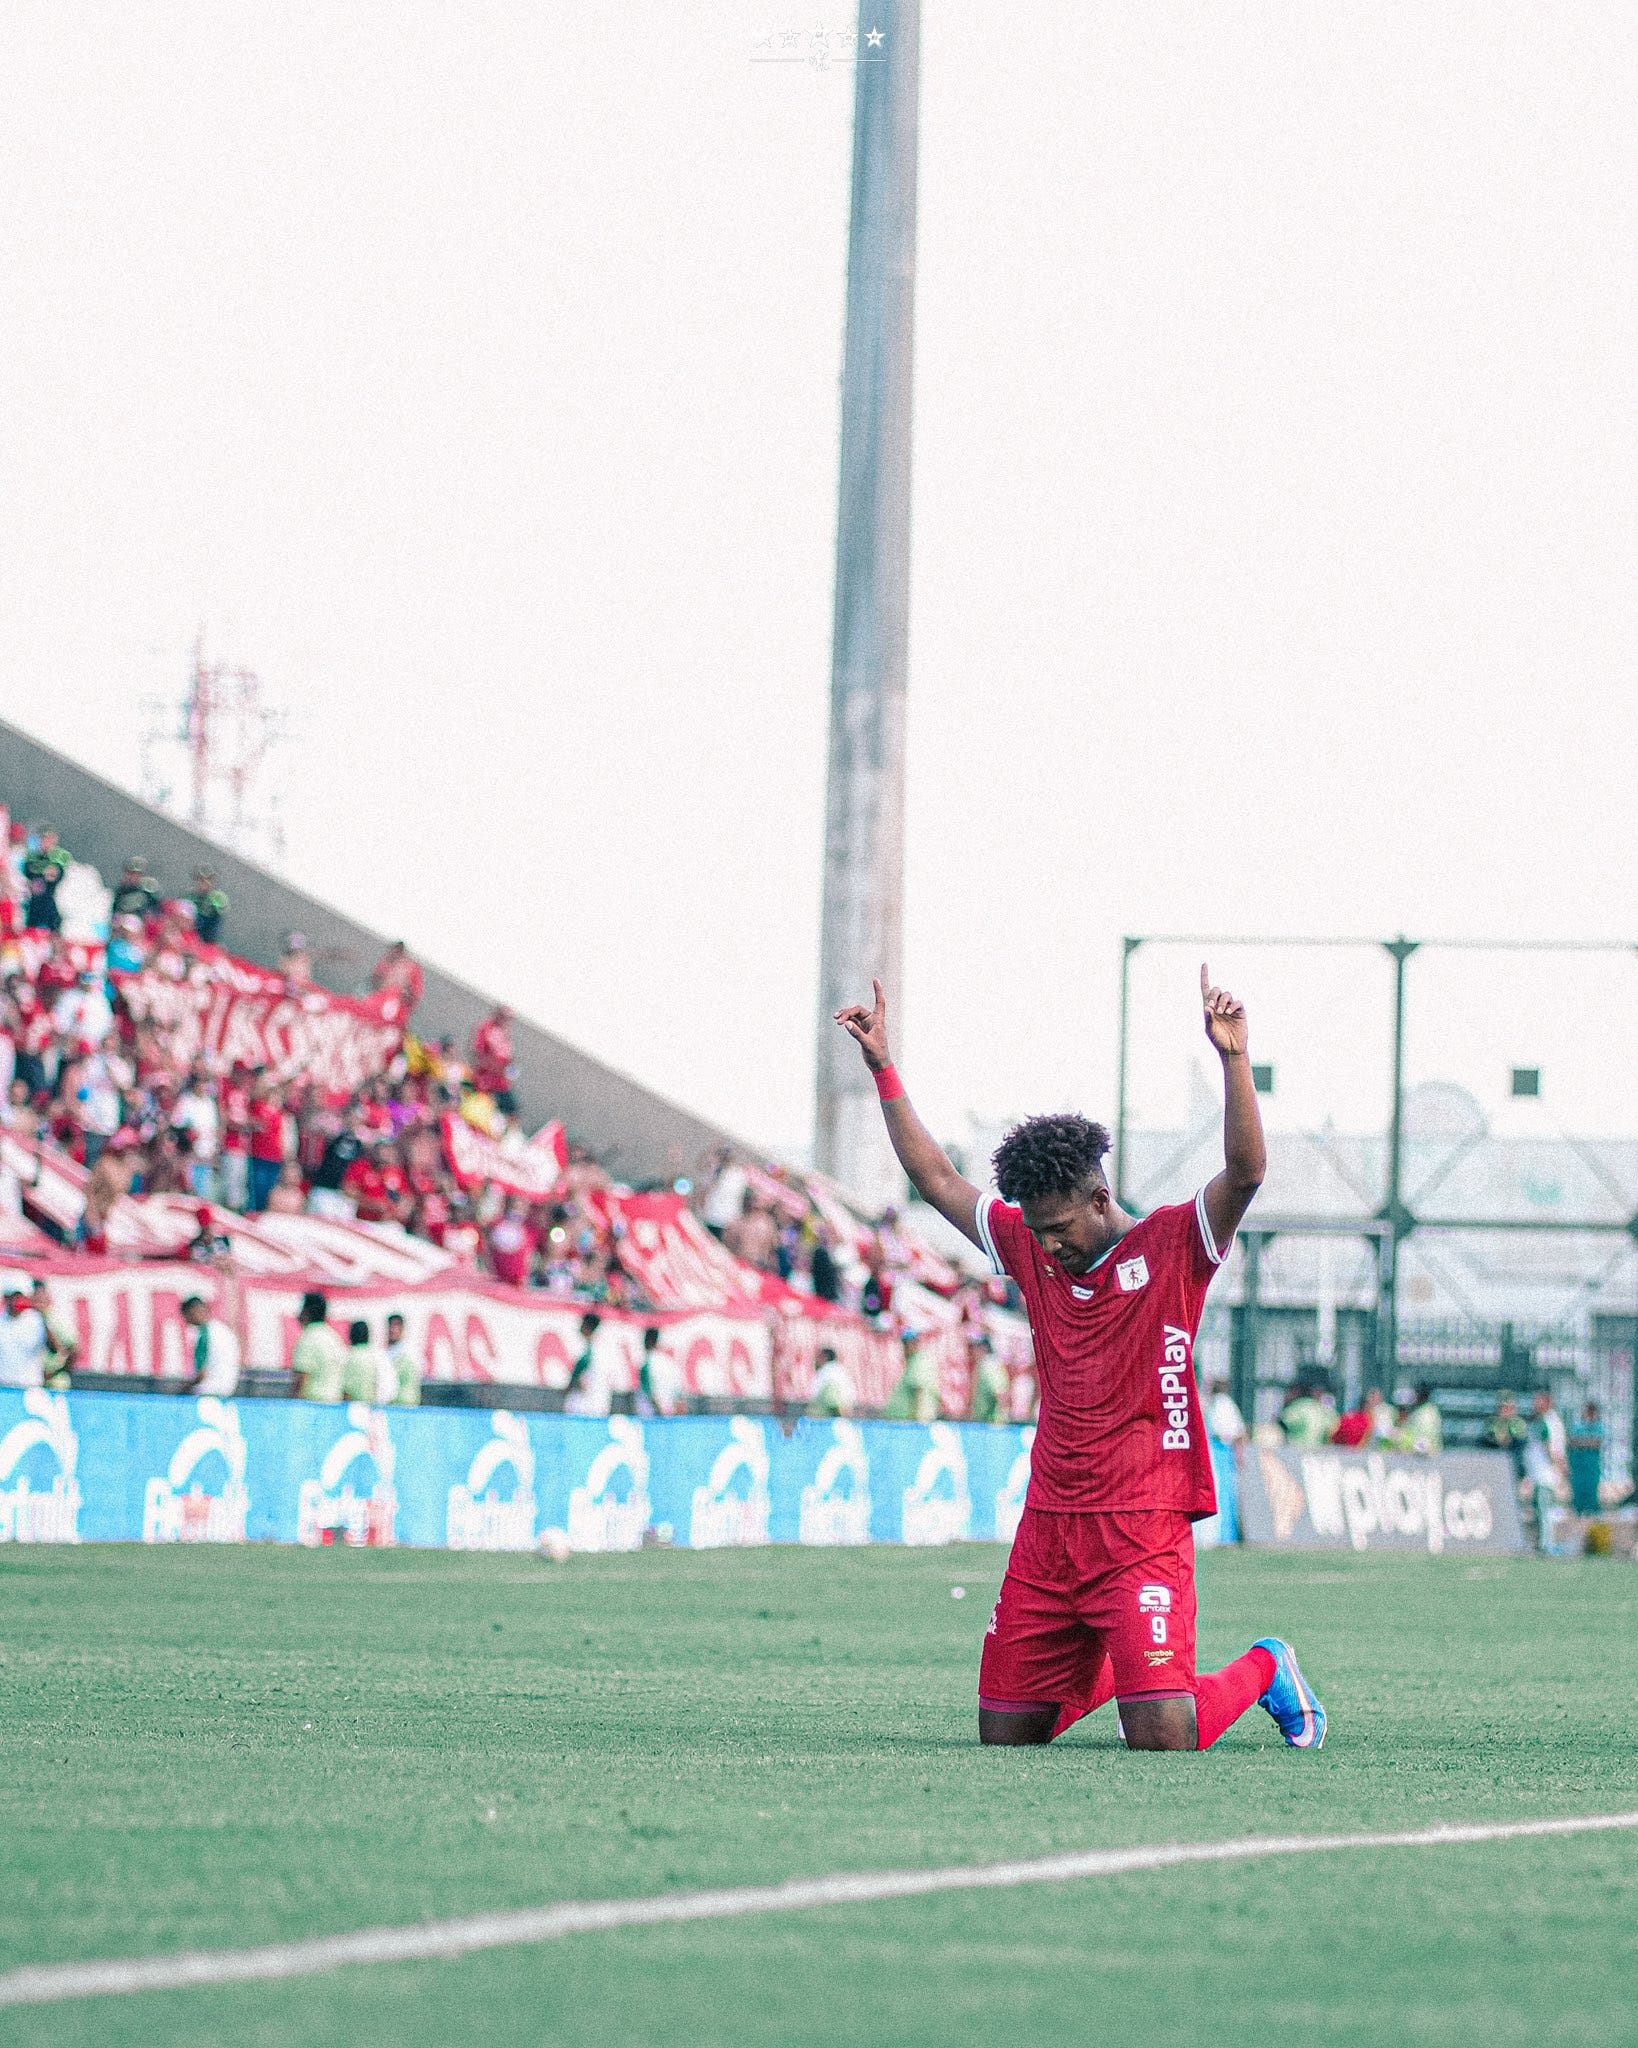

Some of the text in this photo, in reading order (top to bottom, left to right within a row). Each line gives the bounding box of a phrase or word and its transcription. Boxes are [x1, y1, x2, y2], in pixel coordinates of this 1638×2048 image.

[1158, 1324, 1191, 1450] BetPlay
[1151, 1615, 1167, 1644] 9
[1143, 1650, 1175, 1658] Reebok
